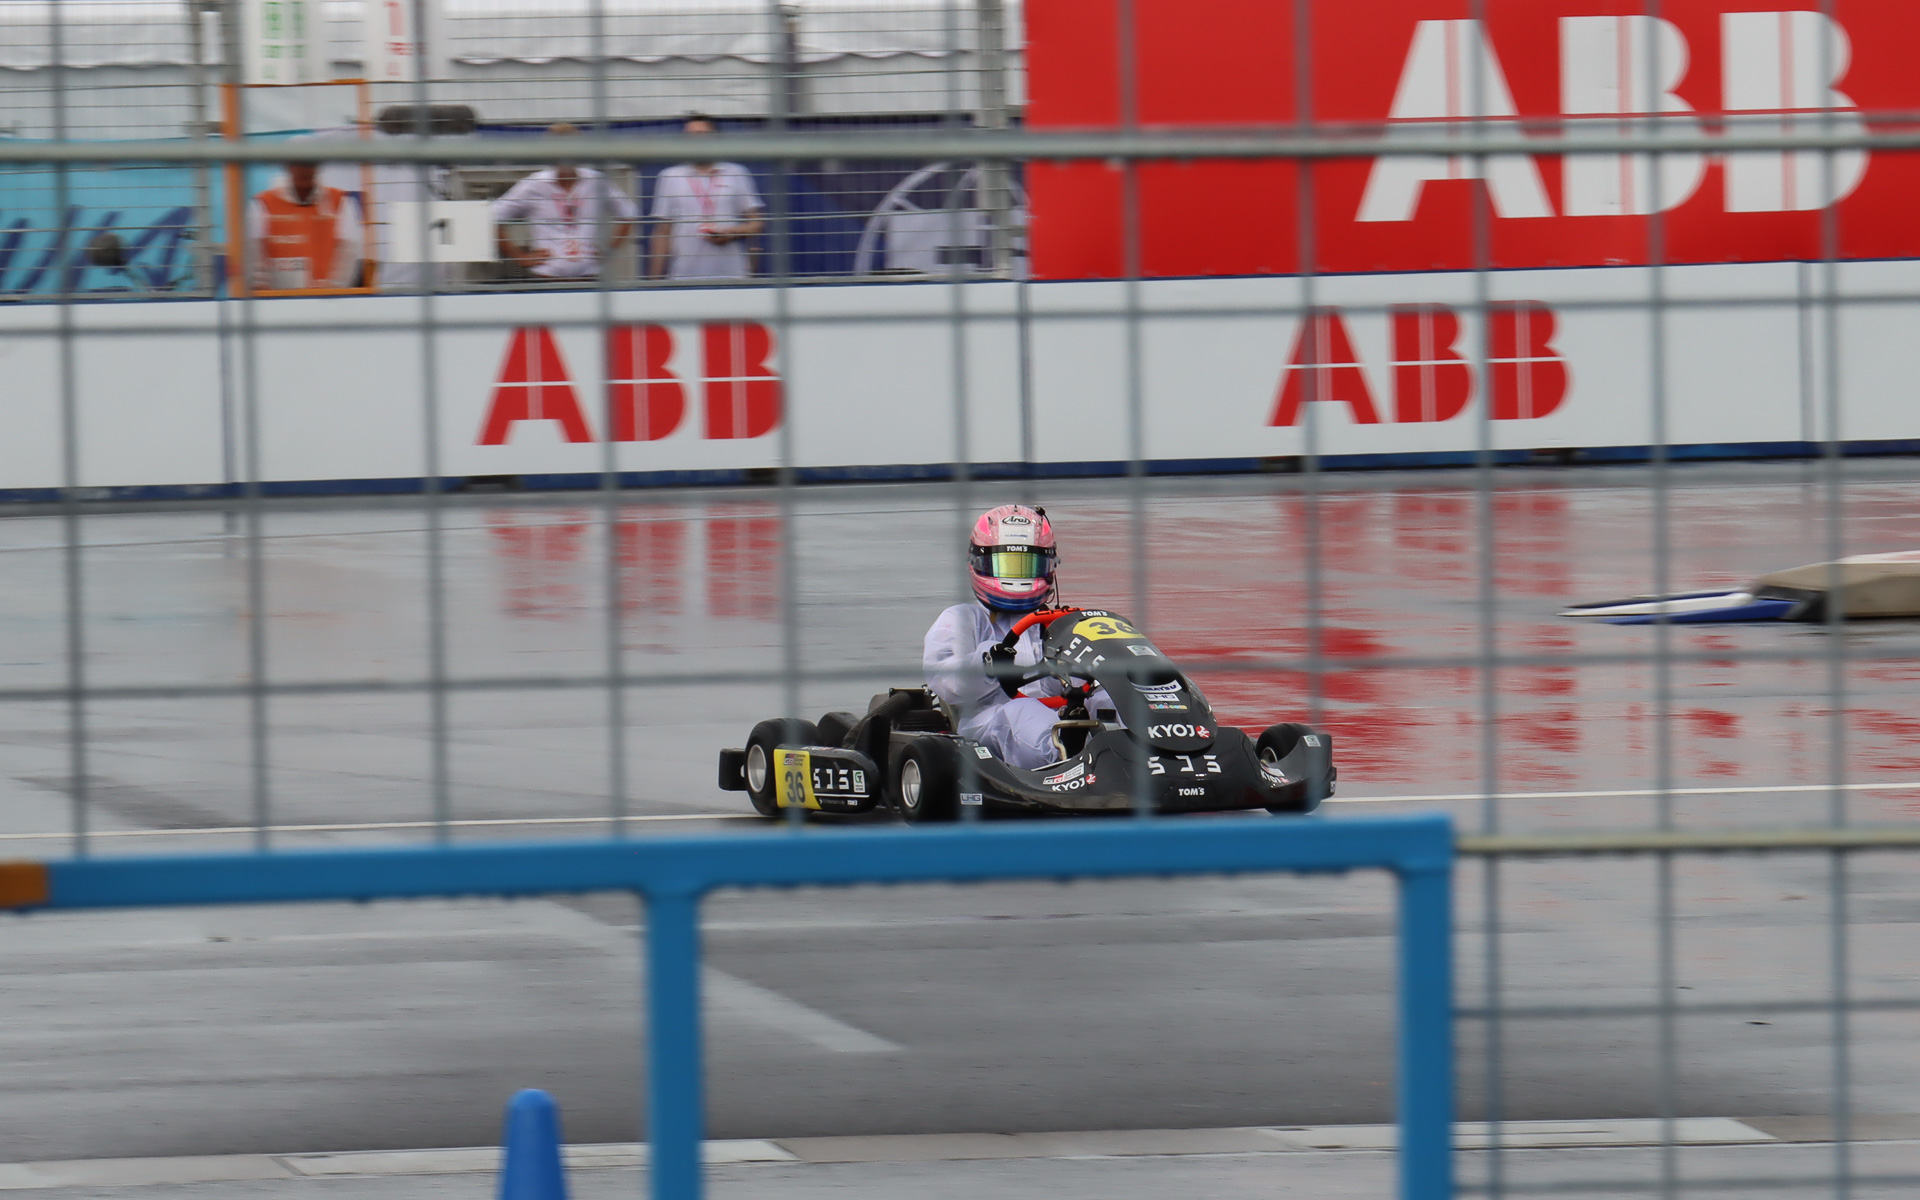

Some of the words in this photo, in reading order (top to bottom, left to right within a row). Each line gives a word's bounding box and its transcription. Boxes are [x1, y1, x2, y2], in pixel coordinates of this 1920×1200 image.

[1354, 10, 1871, 222] ABB
[1264, 299, 1576, 427] ABB
[473, 320, 787, 446] ABB
[1088, 621, 1137, 635] 36
[785, 770, 806, 803] 36
[961, 794, 982, 802] LHG
[1178, 787, 1206, 797] TOM'S
